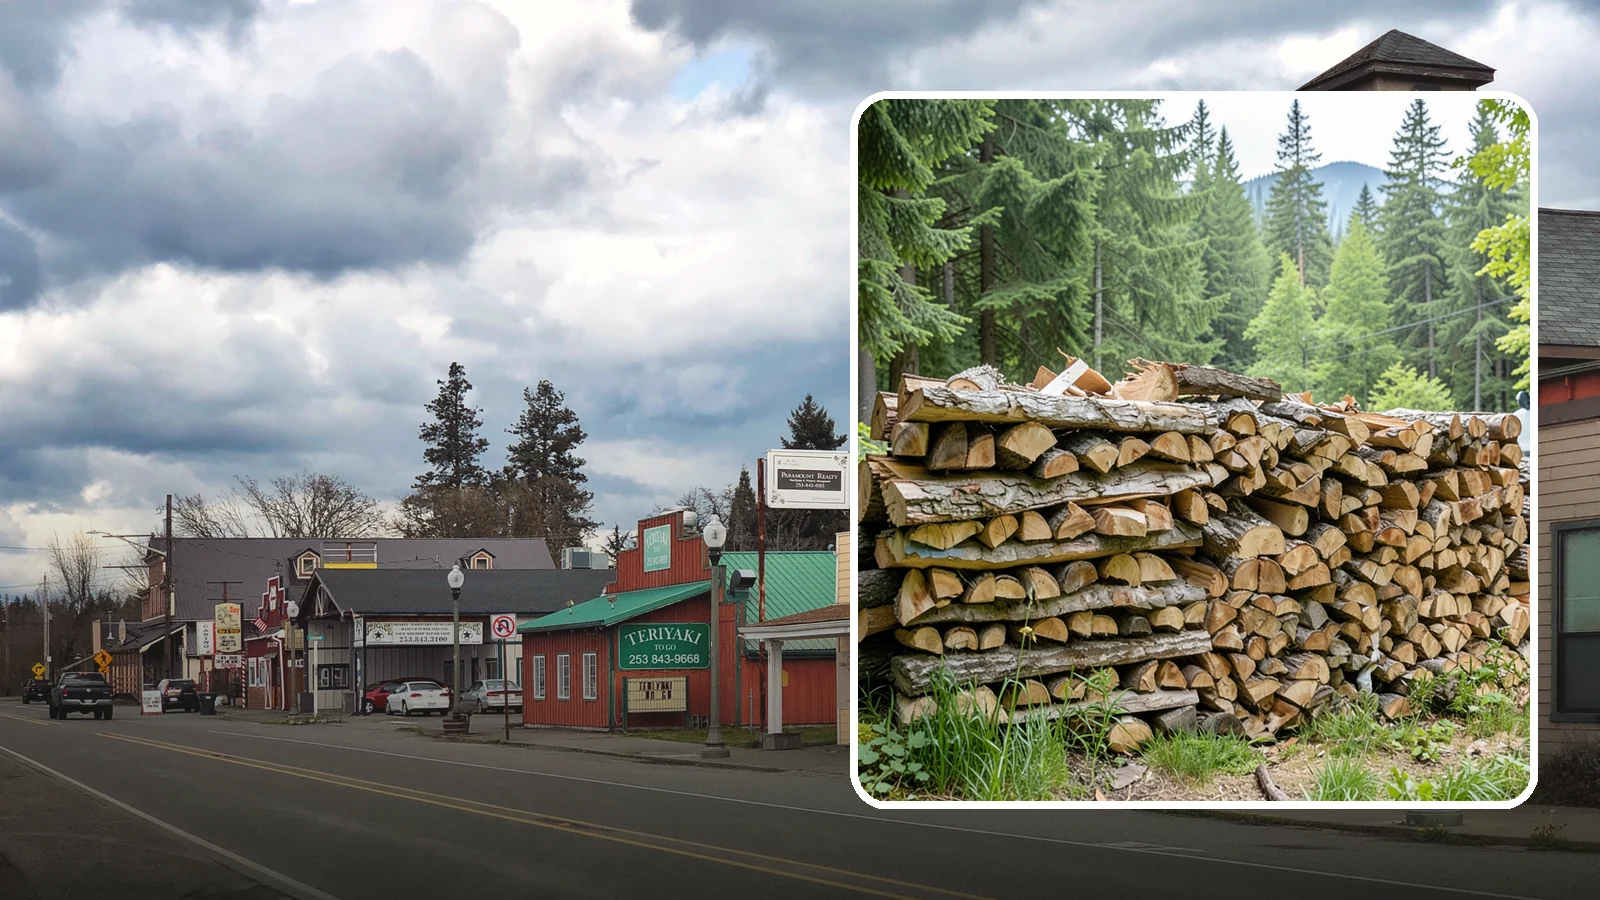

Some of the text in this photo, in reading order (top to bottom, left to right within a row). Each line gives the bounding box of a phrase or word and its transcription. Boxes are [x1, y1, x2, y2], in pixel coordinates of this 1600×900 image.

[625, 628, 702, 646] TERIYAKI
[629, 653, 700, 664] 253 843-9668
[639, 681, 672, 691] TERIYAKI
